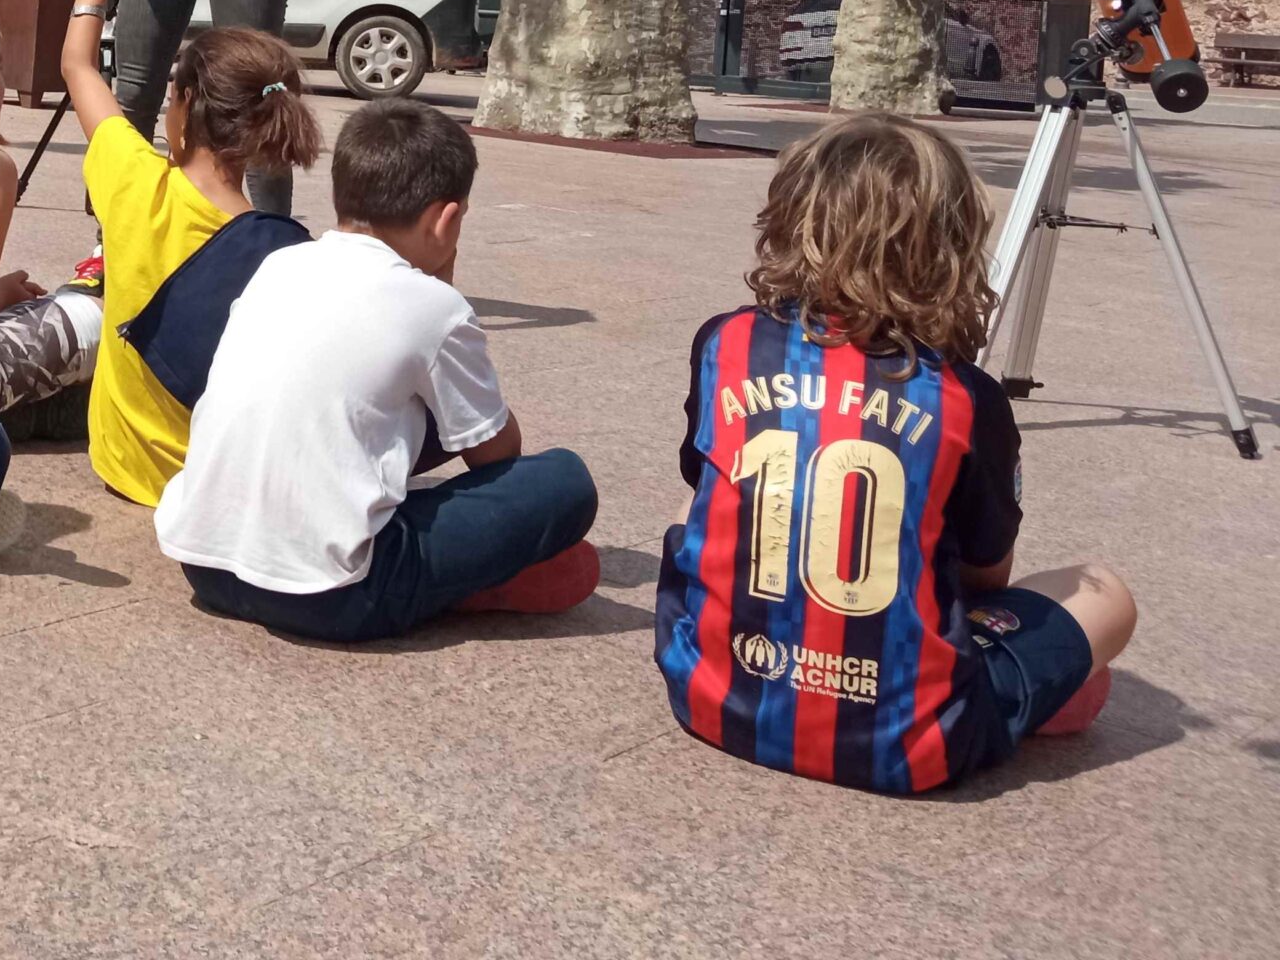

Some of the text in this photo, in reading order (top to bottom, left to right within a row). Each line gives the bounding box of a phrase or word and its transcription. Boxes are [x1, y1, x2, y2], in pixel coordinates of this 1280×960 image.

[720, 373, 934, 446] ANSU FATI
[730, 429, 906, 617] 10
[792, 644, 879, 677] UNHCR
[790, 664, 878, 696] ACNUR
[790, 680, 876, 705] The UN Refugee Agency
